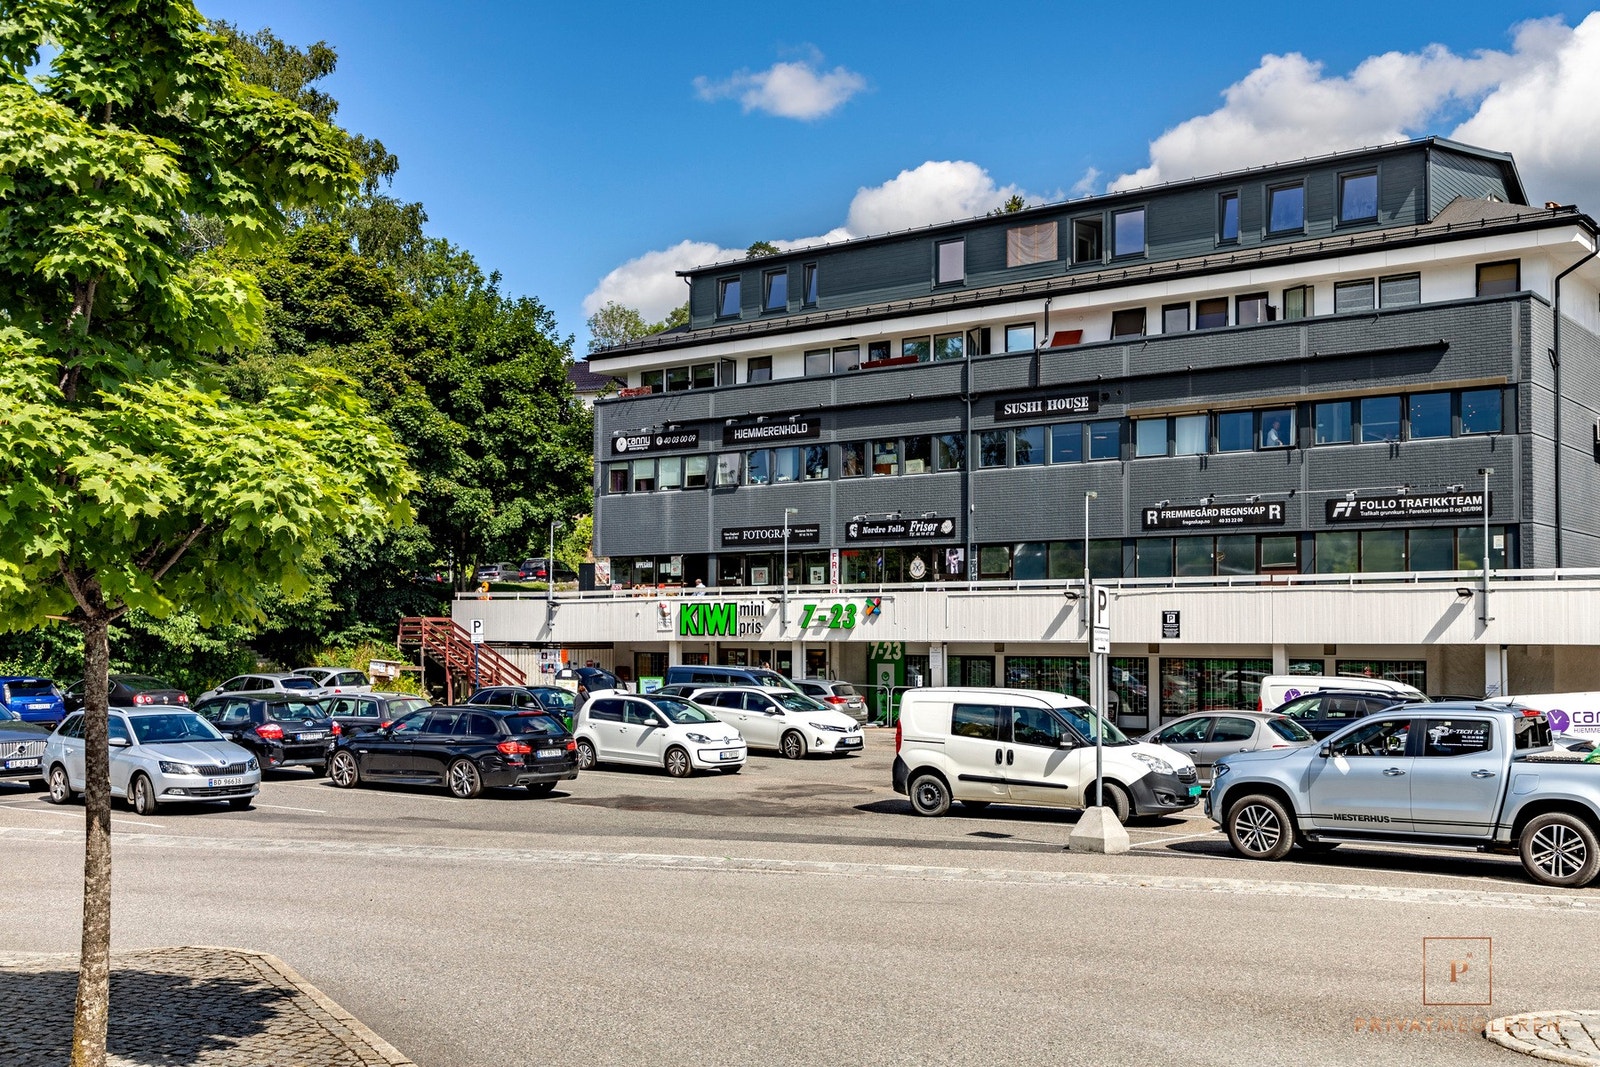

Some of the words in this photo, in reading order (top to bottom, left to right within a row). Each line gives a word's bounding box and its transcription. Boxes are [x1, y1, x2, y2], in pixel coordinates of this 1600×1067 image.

[1004, 401, 1042, 415] SUSHI
[1047, 396, 1089, 411] HOUSE
[734, 423, 808, 439] HJEMMERENHOLD
[627, 436, 651, 446] canny
[1360, 500, 1397, 510] FOLLO
[1399, 496, 1483, 508] TRAFIKKTEAM
[1147, 510, 1158, 525] R
[1161, 506, 1219, 519] FREMMEGÅRD
[1220, 506, 1266, 517] REGNSKAP
[1269, 504, 1281, 520] R
[743, 528, 792, 540] FOTOGRAF
[862, 526, 886, 534] Nordre
[888, 525, 905, 533] Follo
[909, 520, 939, 532] Frisør
[739, 601, 765, 616] mini
[1098, 590, 1107, 624] P
[473, 620, 481, 633] P
[680, 602, 738, 636] KIWI
[739, 621, 762, 637] pris
[870, 641, 902, 660] 7-23
[1333, 813, 1390, 823] MESTERHUS
